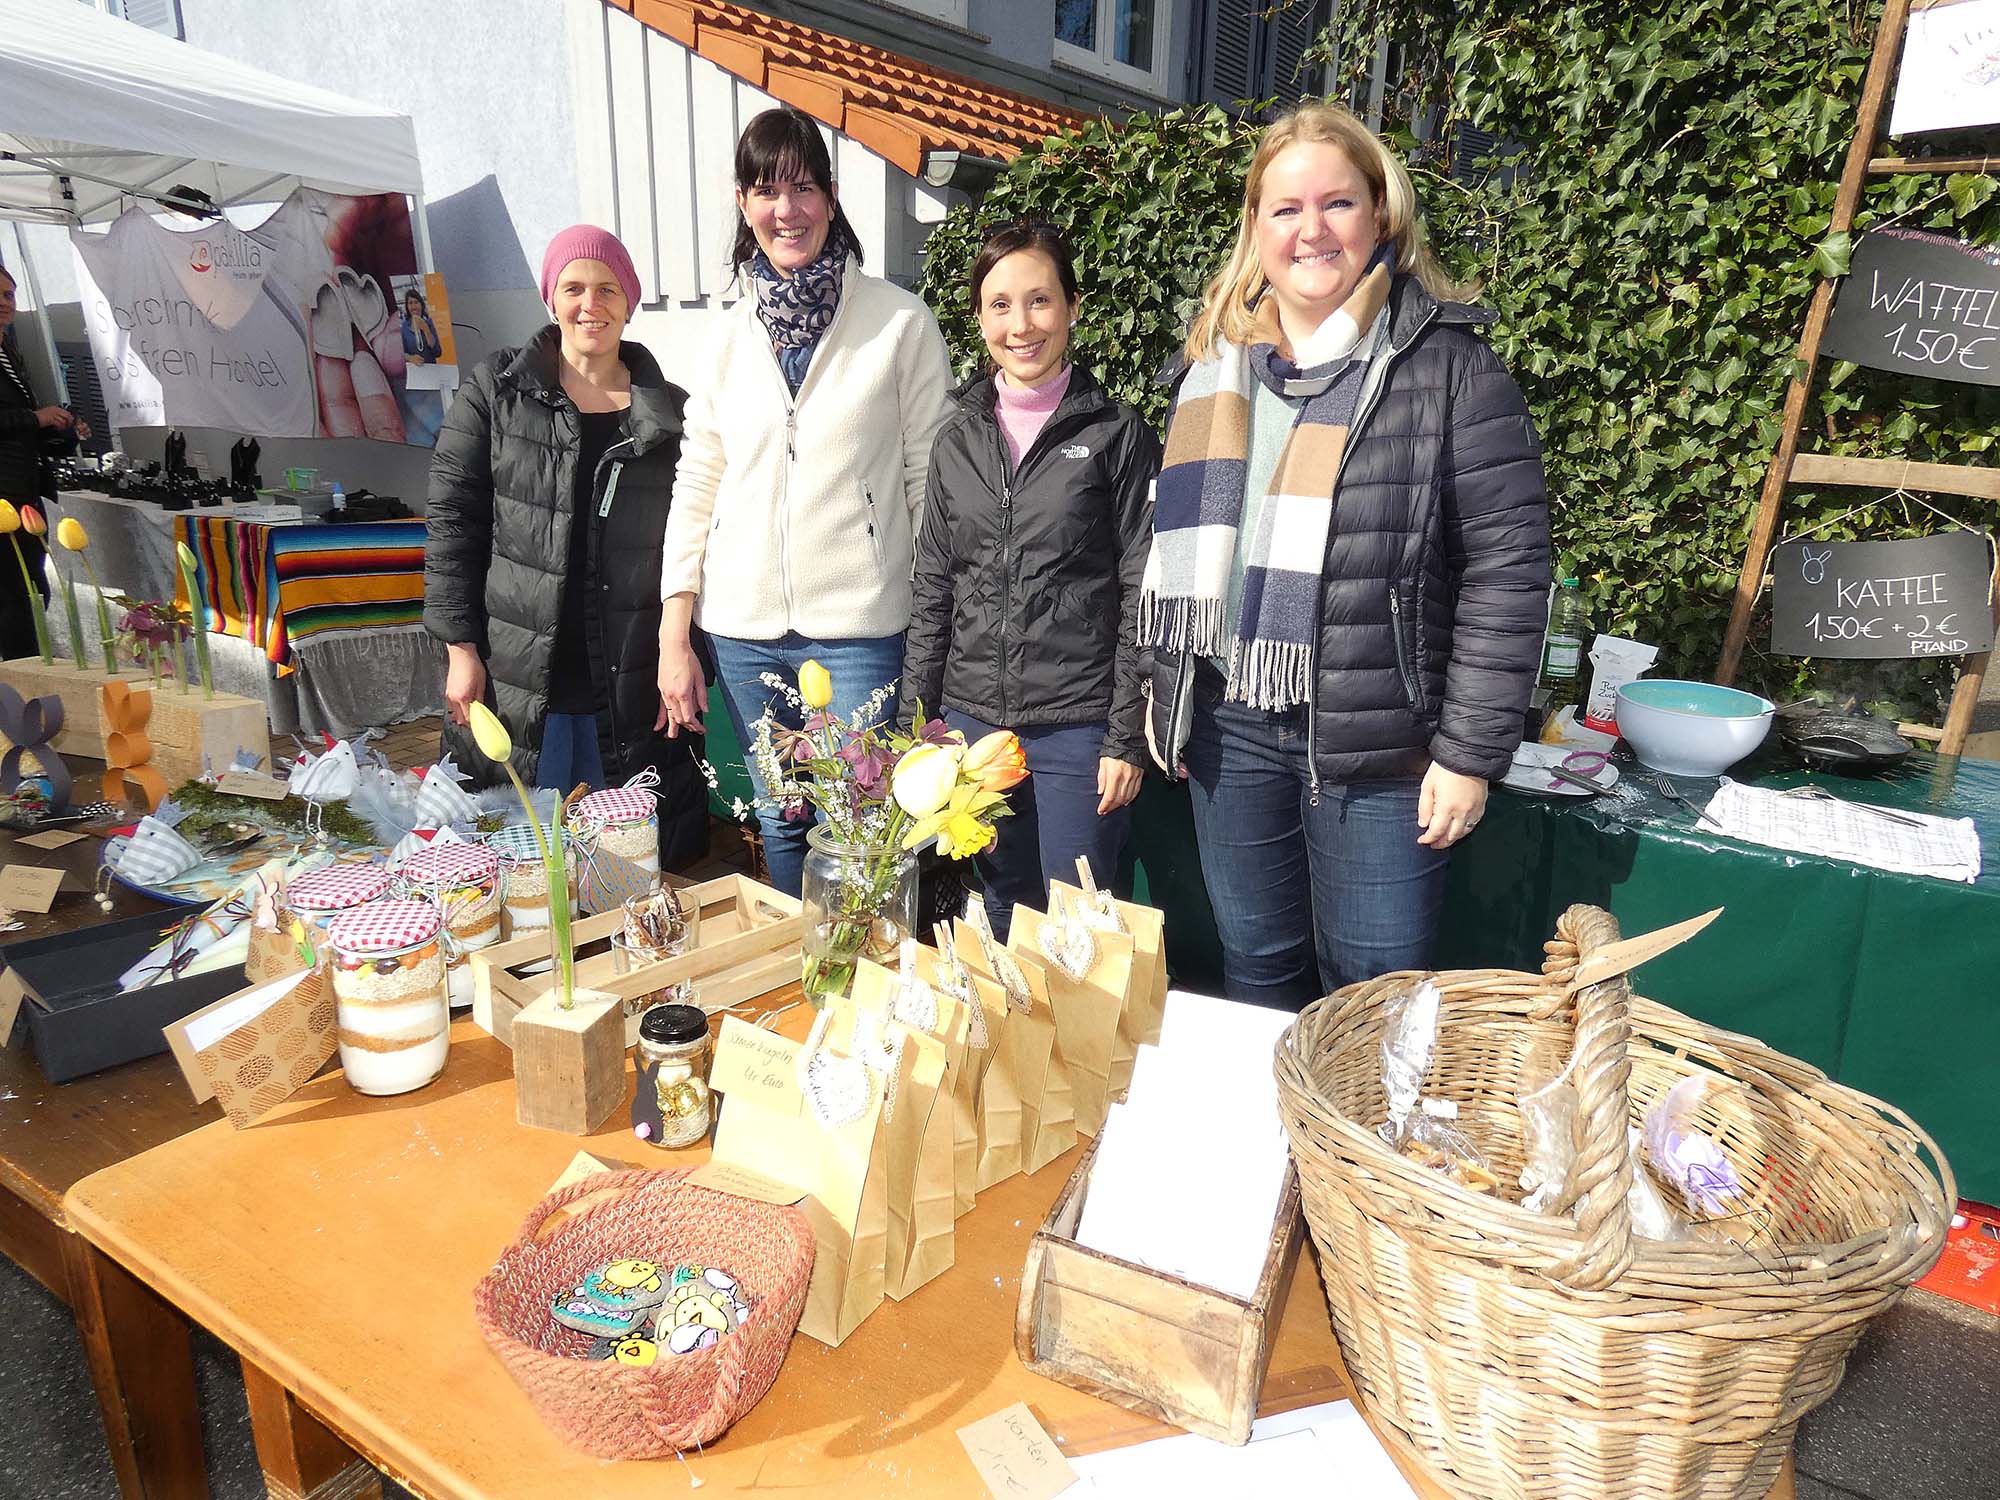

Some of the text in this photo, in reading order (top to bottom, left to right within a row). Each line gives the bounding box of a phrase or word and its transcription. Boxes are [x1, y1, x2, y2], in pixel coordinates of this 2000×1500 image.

[1883, 322, 1997, 370] 1,50€
[1836, 572, 1949, 609] KAFFEE
[1804, 612, 1885, 642] 1,50€
